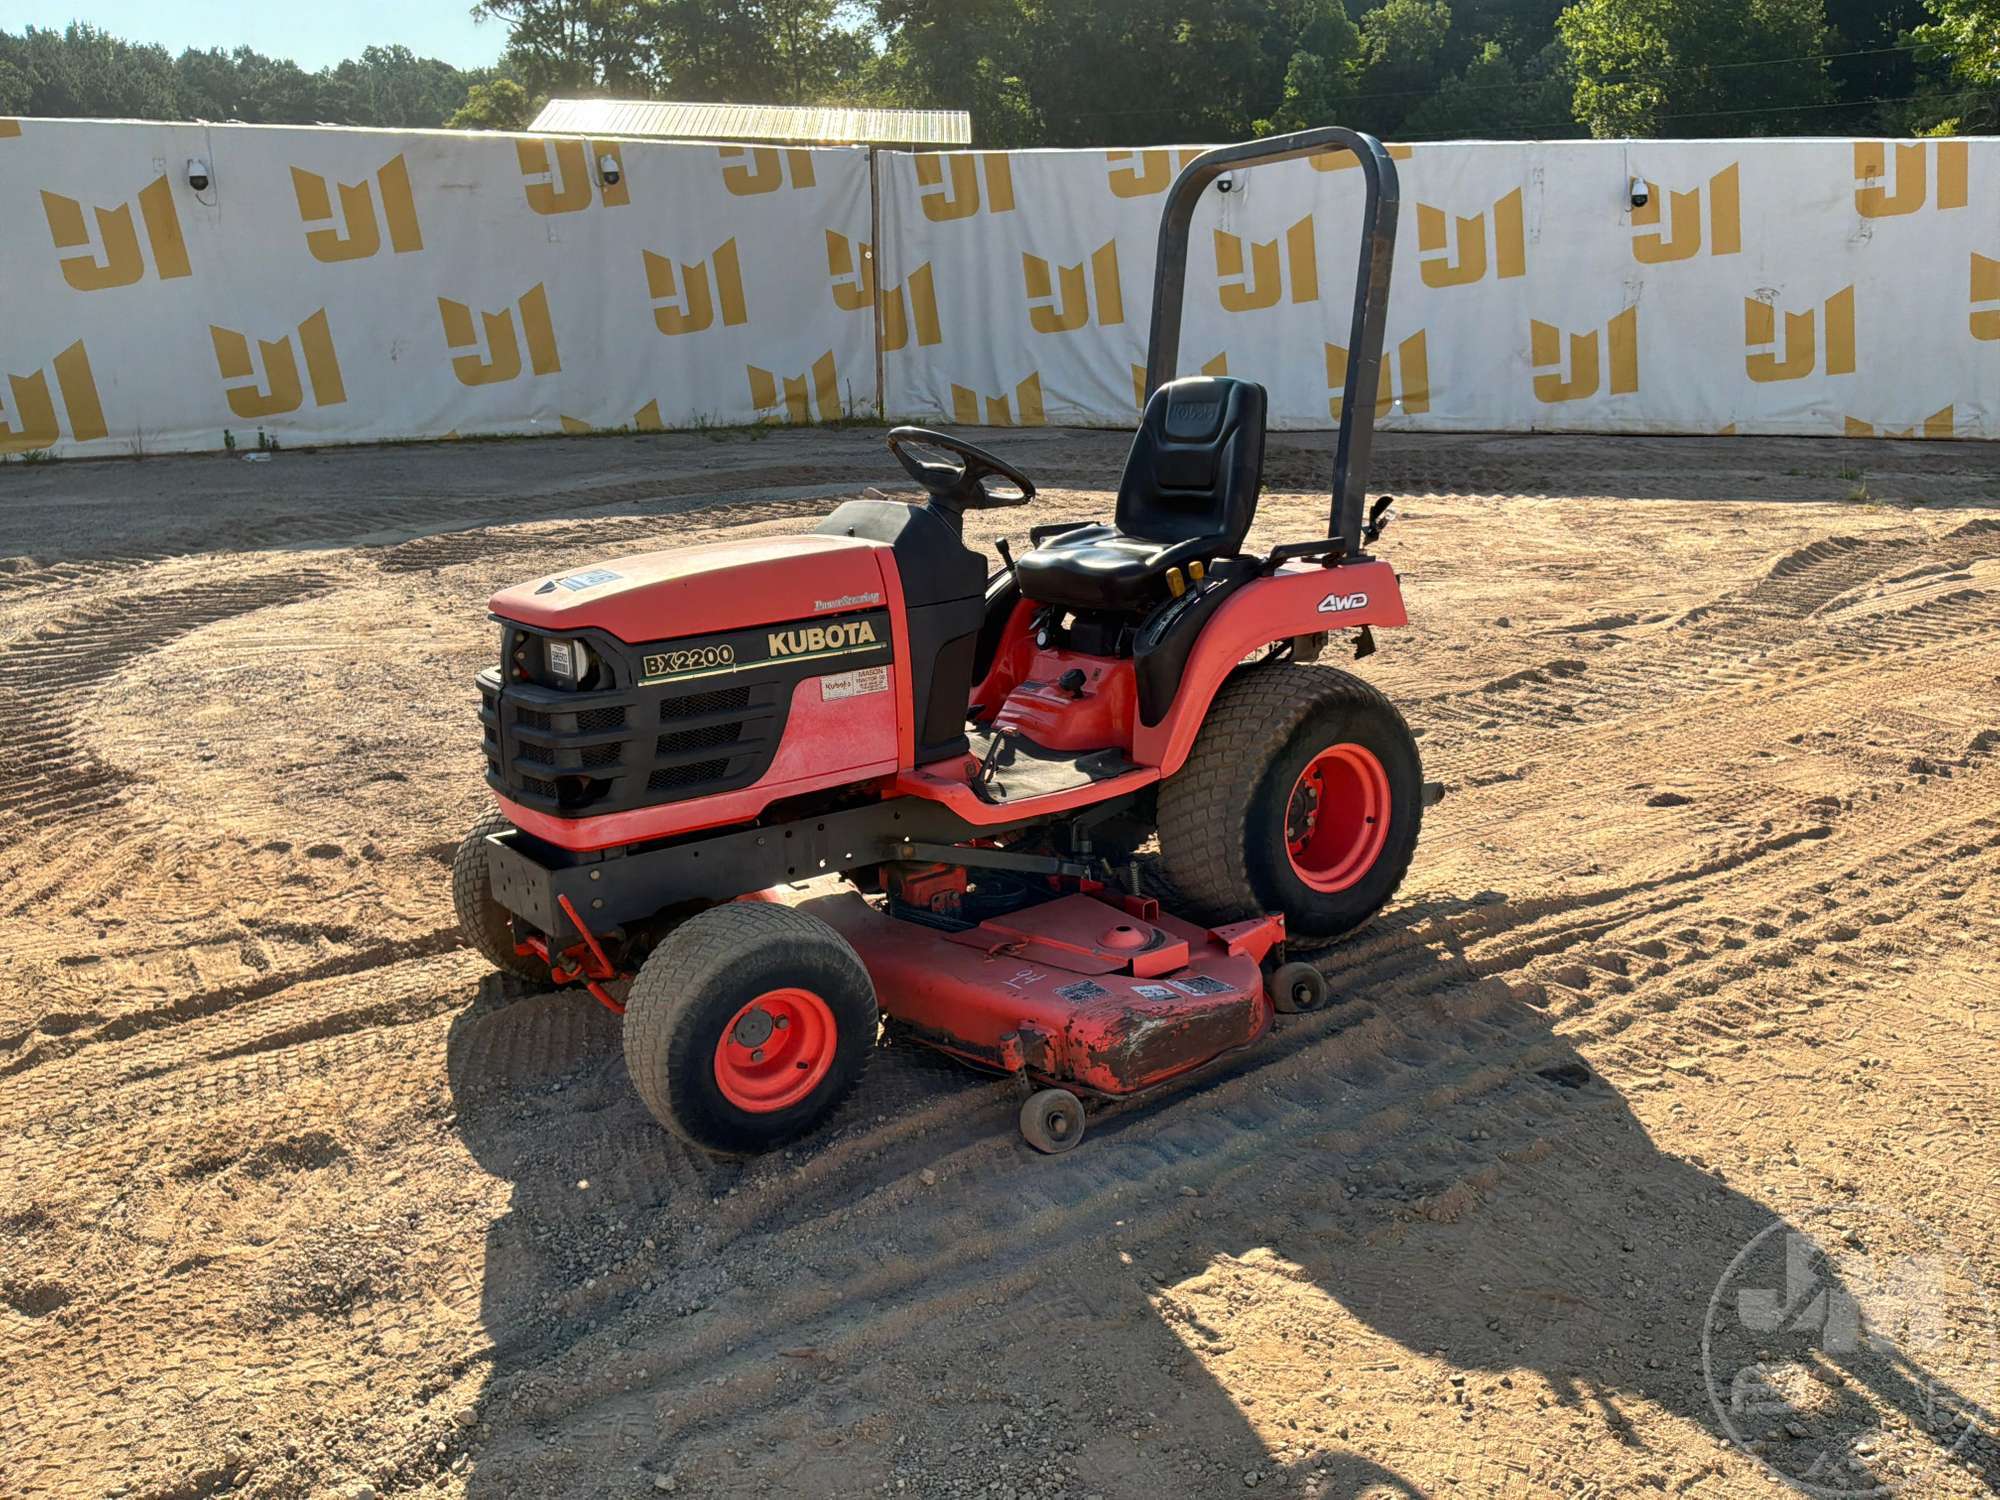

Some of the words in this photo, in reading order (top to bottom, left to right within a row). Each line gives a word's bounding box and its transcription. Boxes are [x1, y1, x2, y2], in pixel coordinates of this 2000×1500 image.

[1317, 592, 1368, 613] 4WD
[767, 620, 876, 657] KUBOTA
[643, 644, 735, 677] BX2200
